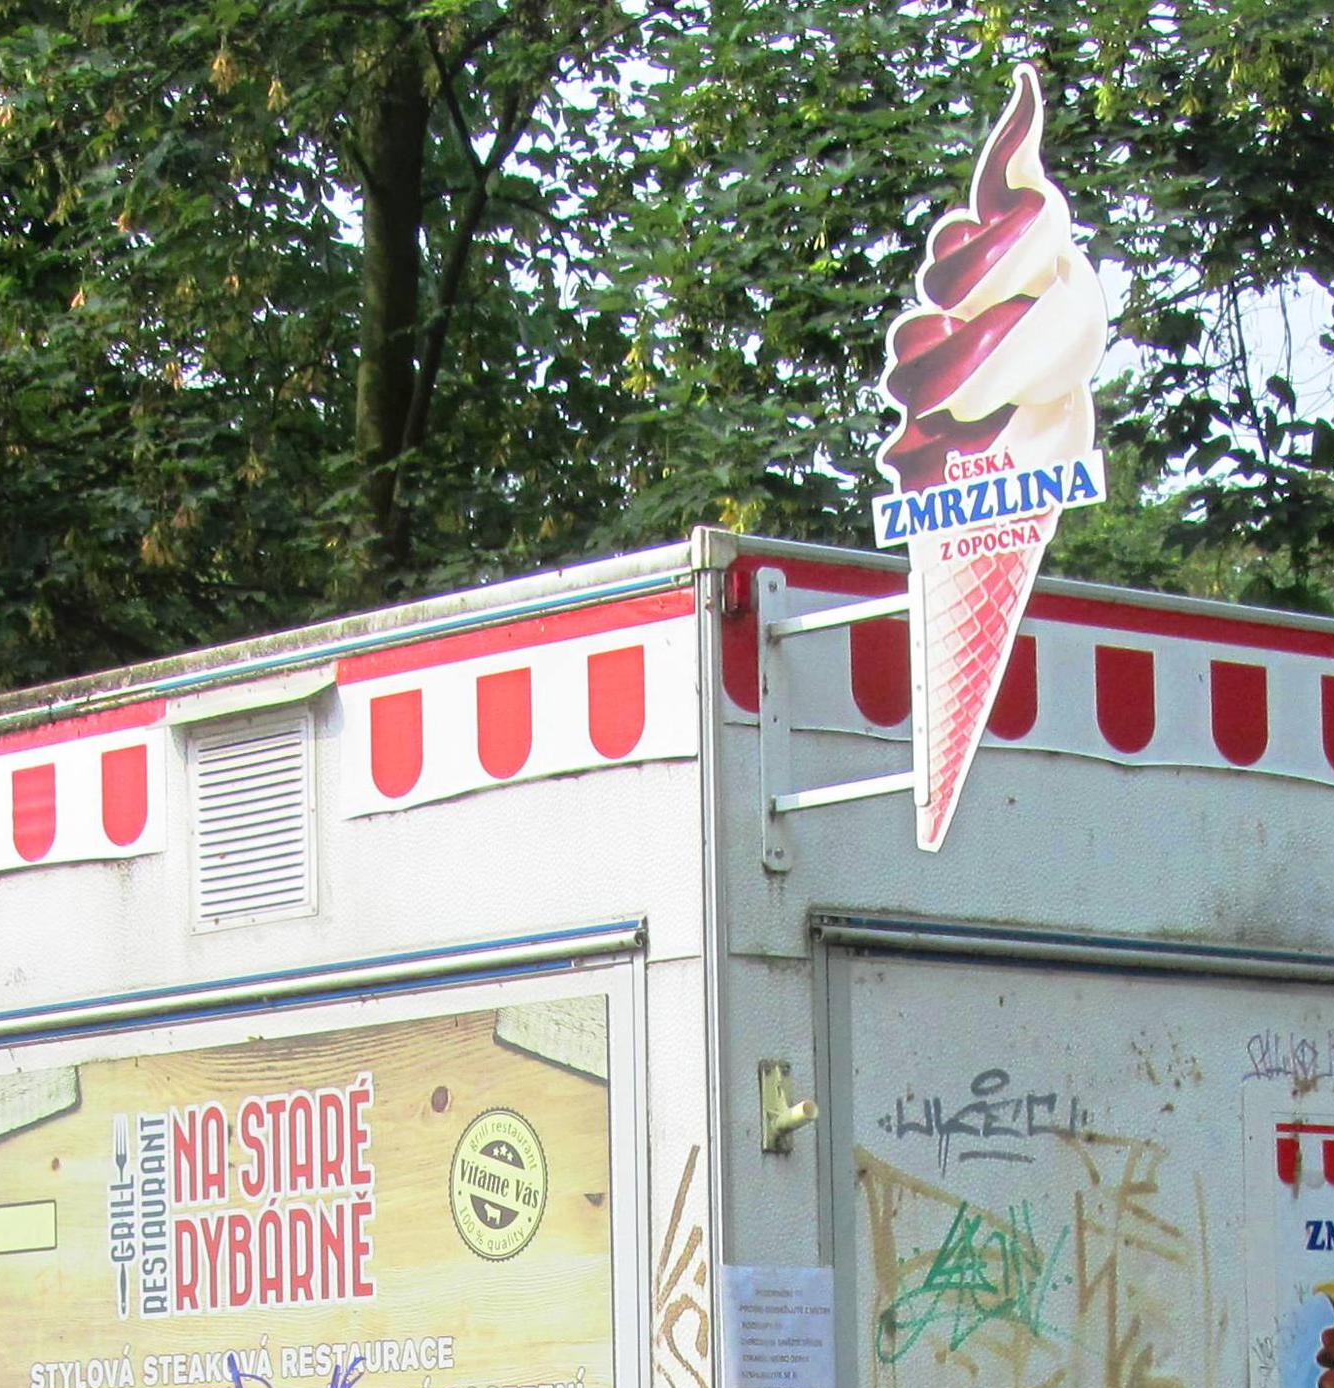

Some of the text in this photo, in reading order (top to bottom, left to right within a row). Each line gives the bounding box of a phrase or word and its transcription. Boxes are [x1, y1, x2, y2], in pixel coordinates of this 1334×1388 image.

[948, 446, 1015, 483] ČESKÁ
[880, 460, 1098, 540] ZMRZLINA
[940, 523, 1042, 561] Z OPOČNA
[173, 1078, 372, 1204] NA STARÉ
[470, 1121, 538, 1171] grill restaurant
[460, 1158, 540, 1209] Vítáme Vás
[110, 1175, 136, 1263] GRILL
[140, 1117, 168, 1314] RESTAURANT
[459, 1206, 476, 1234] 100
[487, 1226, 526, 1253] quality
[174, 1191, 374, 1311] RYBÁRNĚ
[142, 1333, 274, 1387] STEAKOVÁ
[281, 1335, 455, 1378] RESTAURACE
